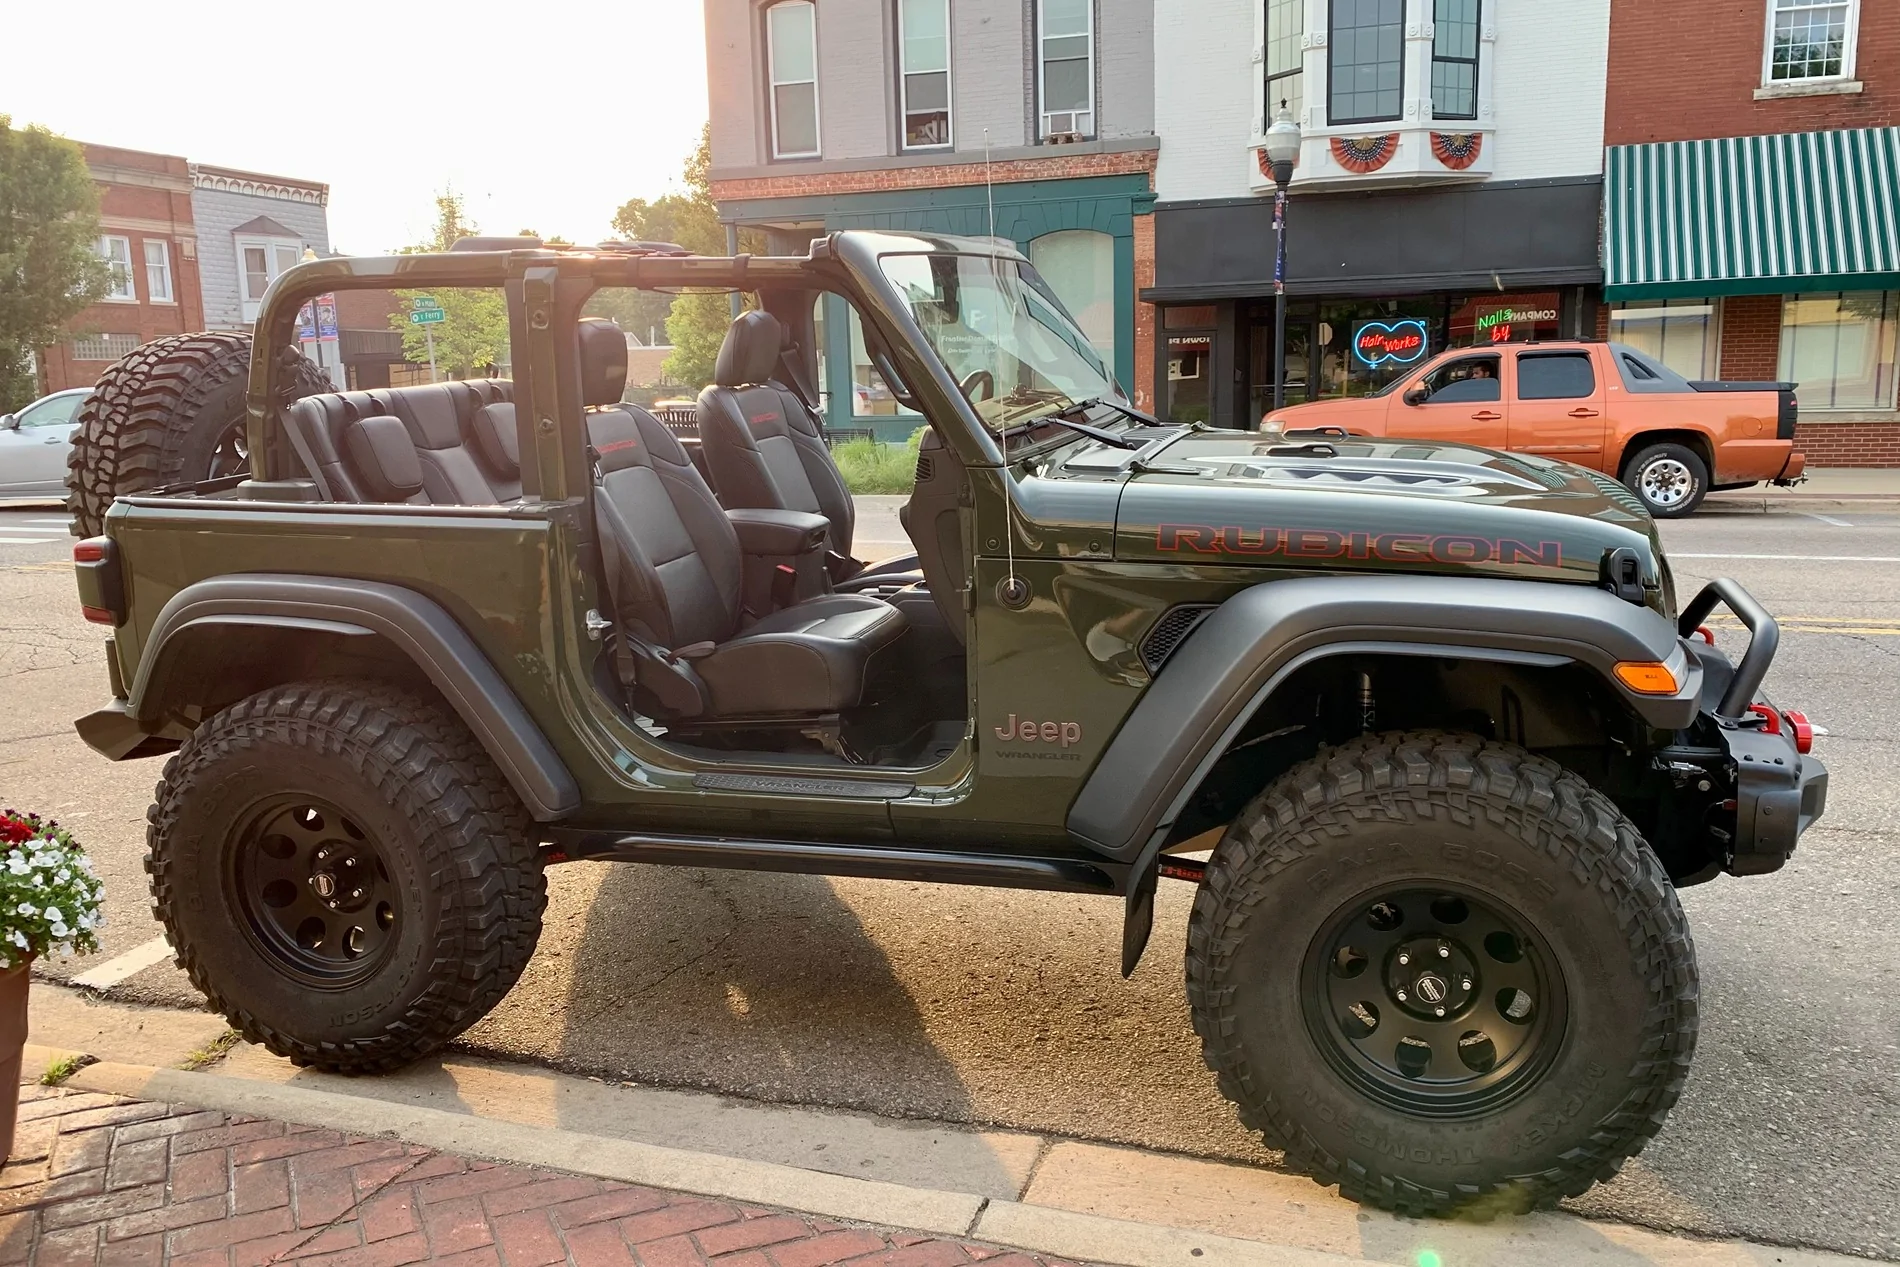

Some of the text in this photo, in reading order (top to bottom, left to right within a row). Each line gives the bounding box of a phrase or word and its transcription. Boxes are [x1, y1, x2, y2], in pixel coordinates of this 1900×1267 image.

[1478, 308, 1513, 331] Nails
[1492, 324, 1510, 342] by
[1360, 334, 1419, 352] Hair Works
[1156, 523, 1562, 568] RUBICON
[995, 713, 1082, 748] Jeep
[995, 750, 1083, 761] WRANGLER
[1307, 842, 1559, 903] BAJA BOSS
[1297, 1085, 1482, 1167] THOMPSON
